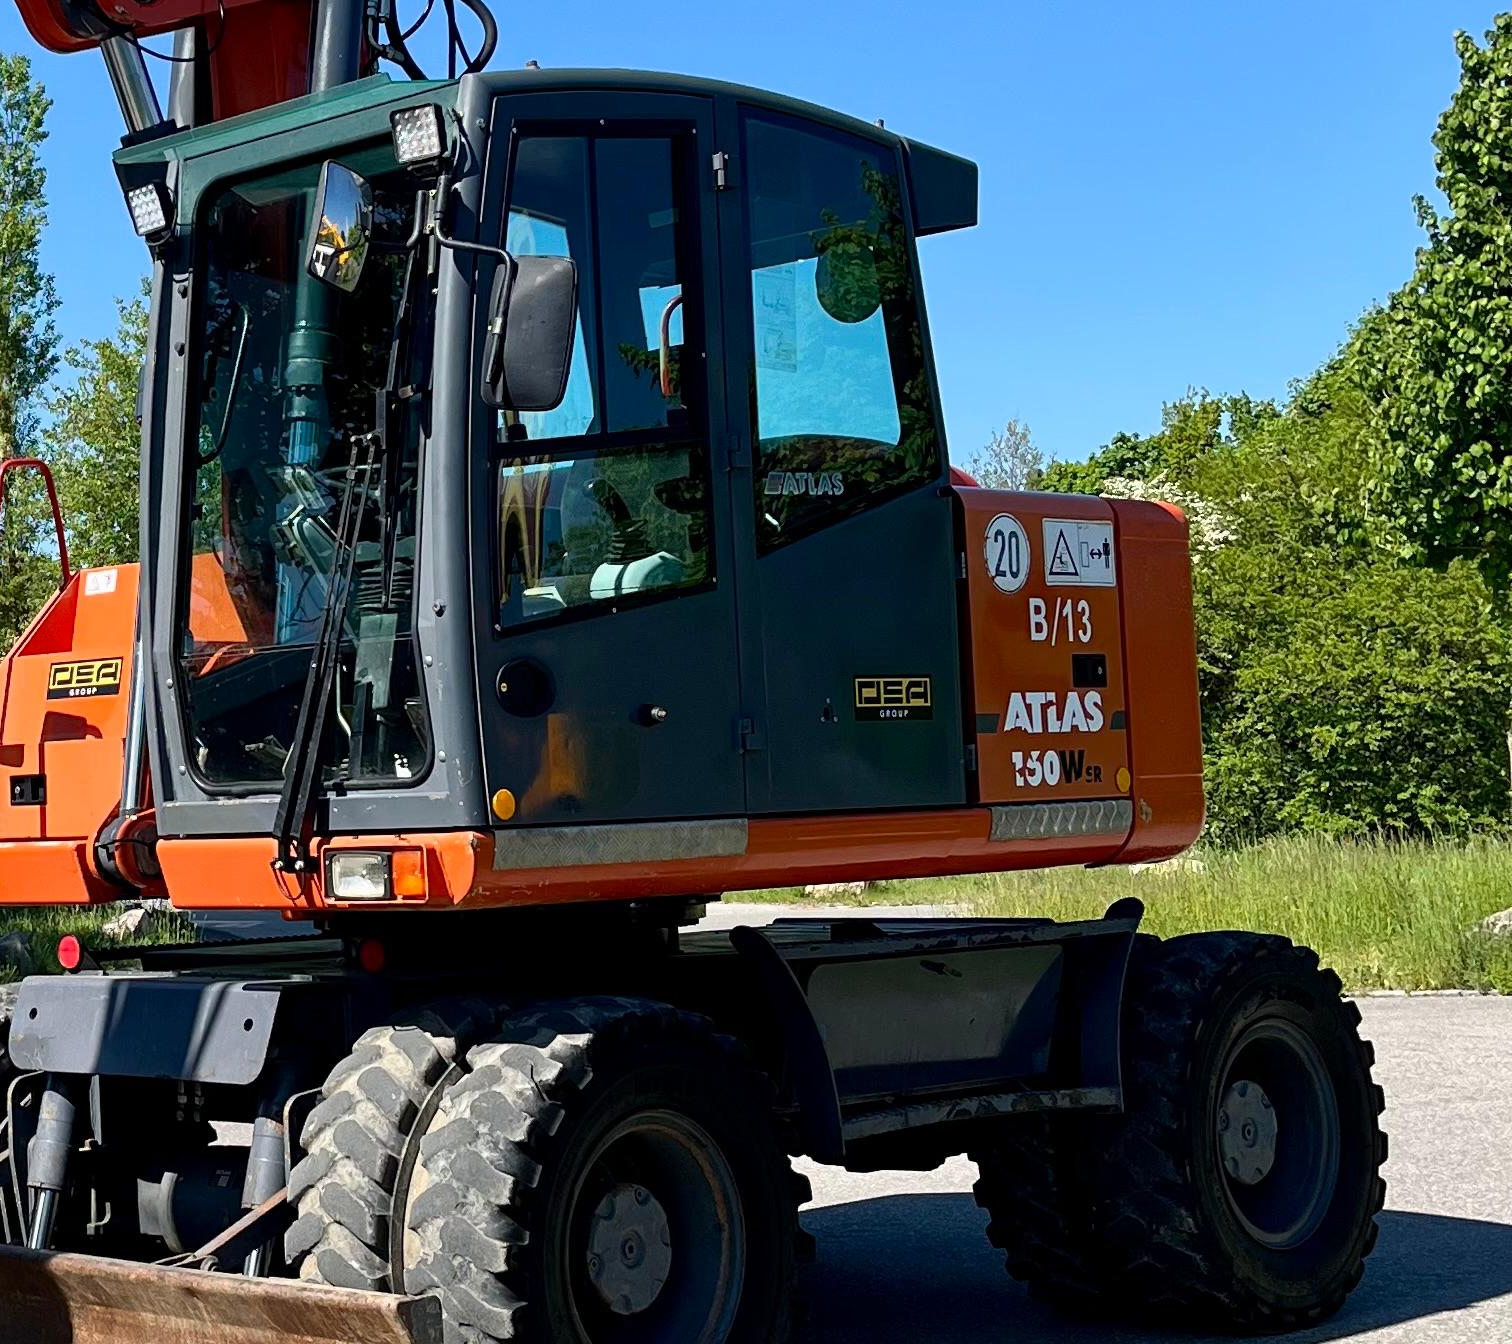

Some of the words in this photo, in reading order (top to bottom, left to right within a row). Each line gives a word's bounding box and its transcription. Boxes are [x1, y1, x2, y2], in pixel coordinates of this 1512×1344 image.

[782, 472, 845, 495] ATLAS
[994, 528, 1020, 579] 20
[1028, 596, 1092, 646] B/13
[68, 686, 98, 697] GROUP
[879, 709, 909, 718] GROUP
[1004, 690, 1104, 733] ATLAS
